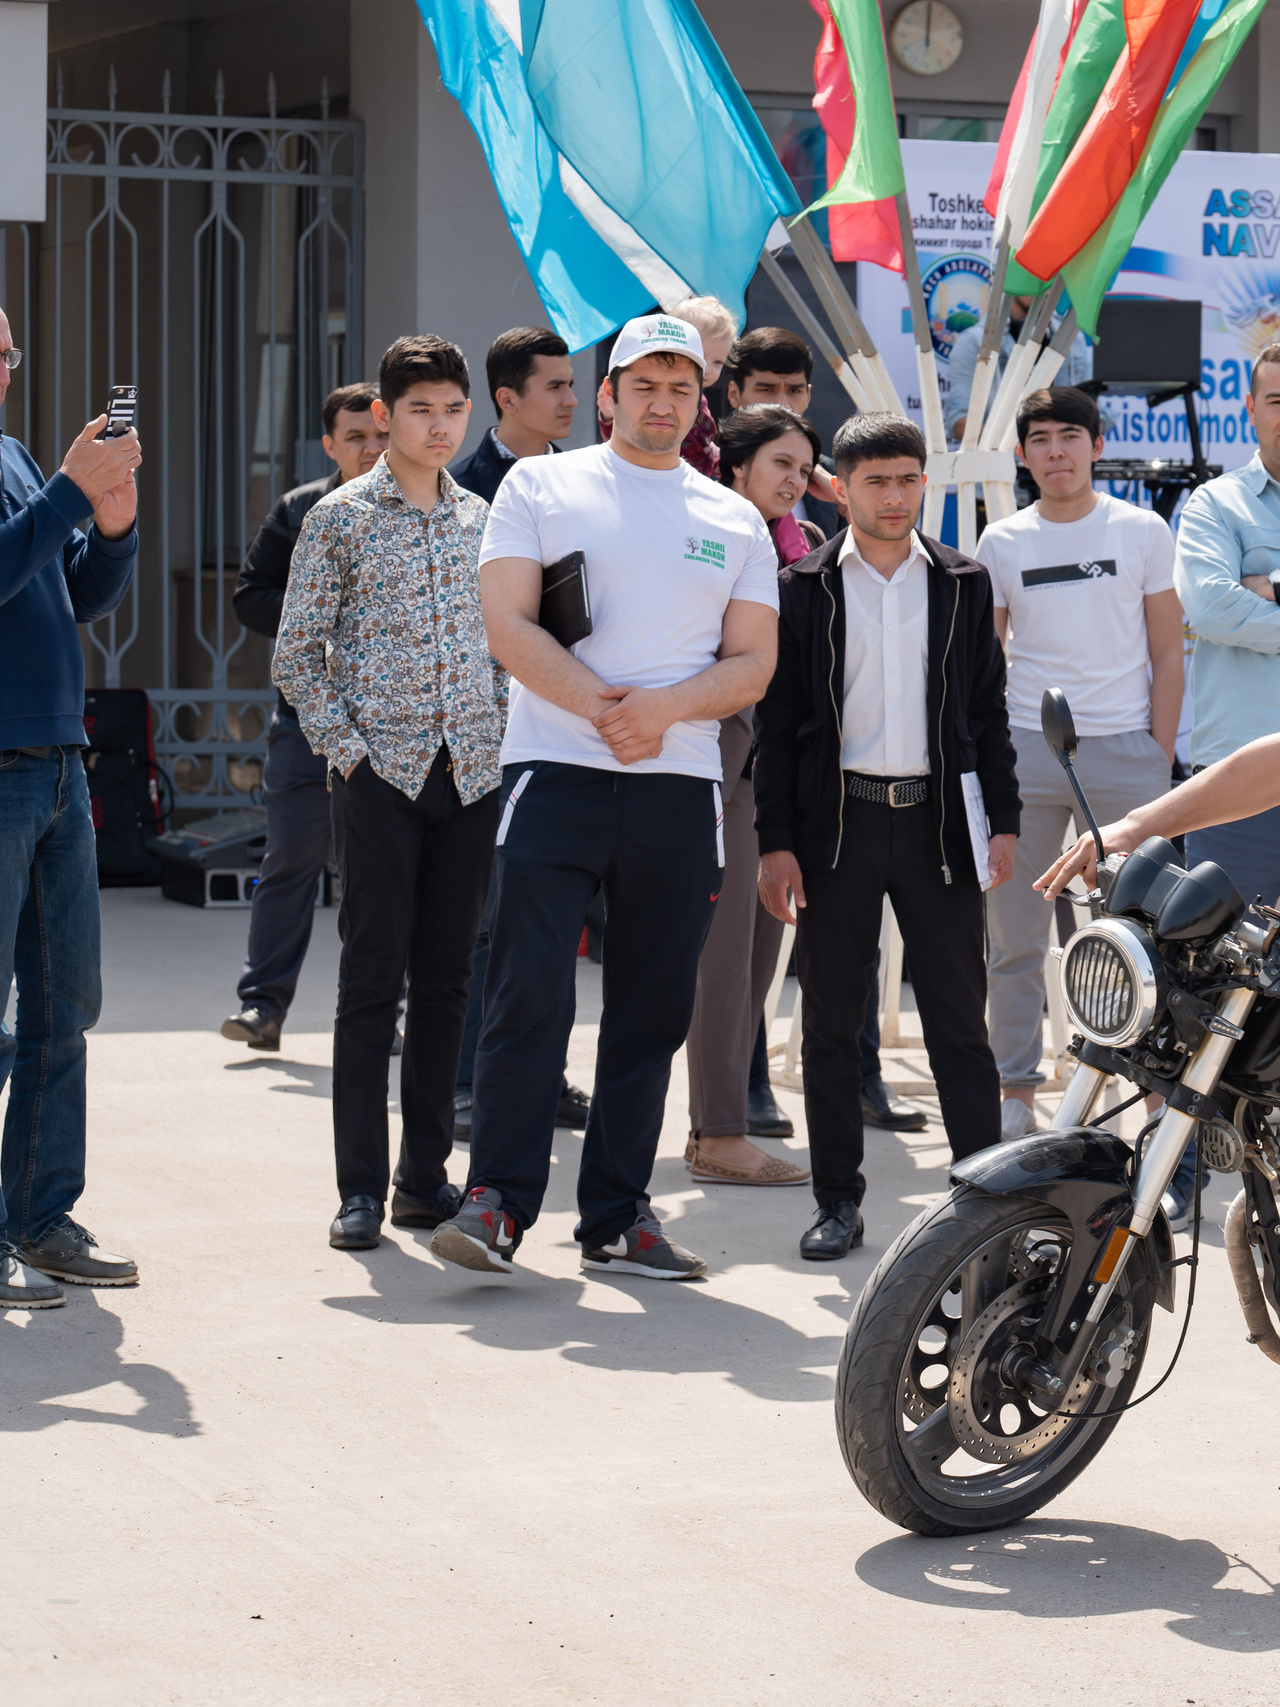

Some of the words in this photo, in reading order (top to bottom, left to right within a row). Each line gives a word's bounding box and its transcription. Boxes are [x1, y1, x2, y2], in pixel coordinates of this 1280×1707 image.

[928, 192, 988, 214] Toshke
[658, 329, 687, 339] MAKON
[702, 538, 726, 553] YASHIL
[701, 547, 726, 562] MAKON
